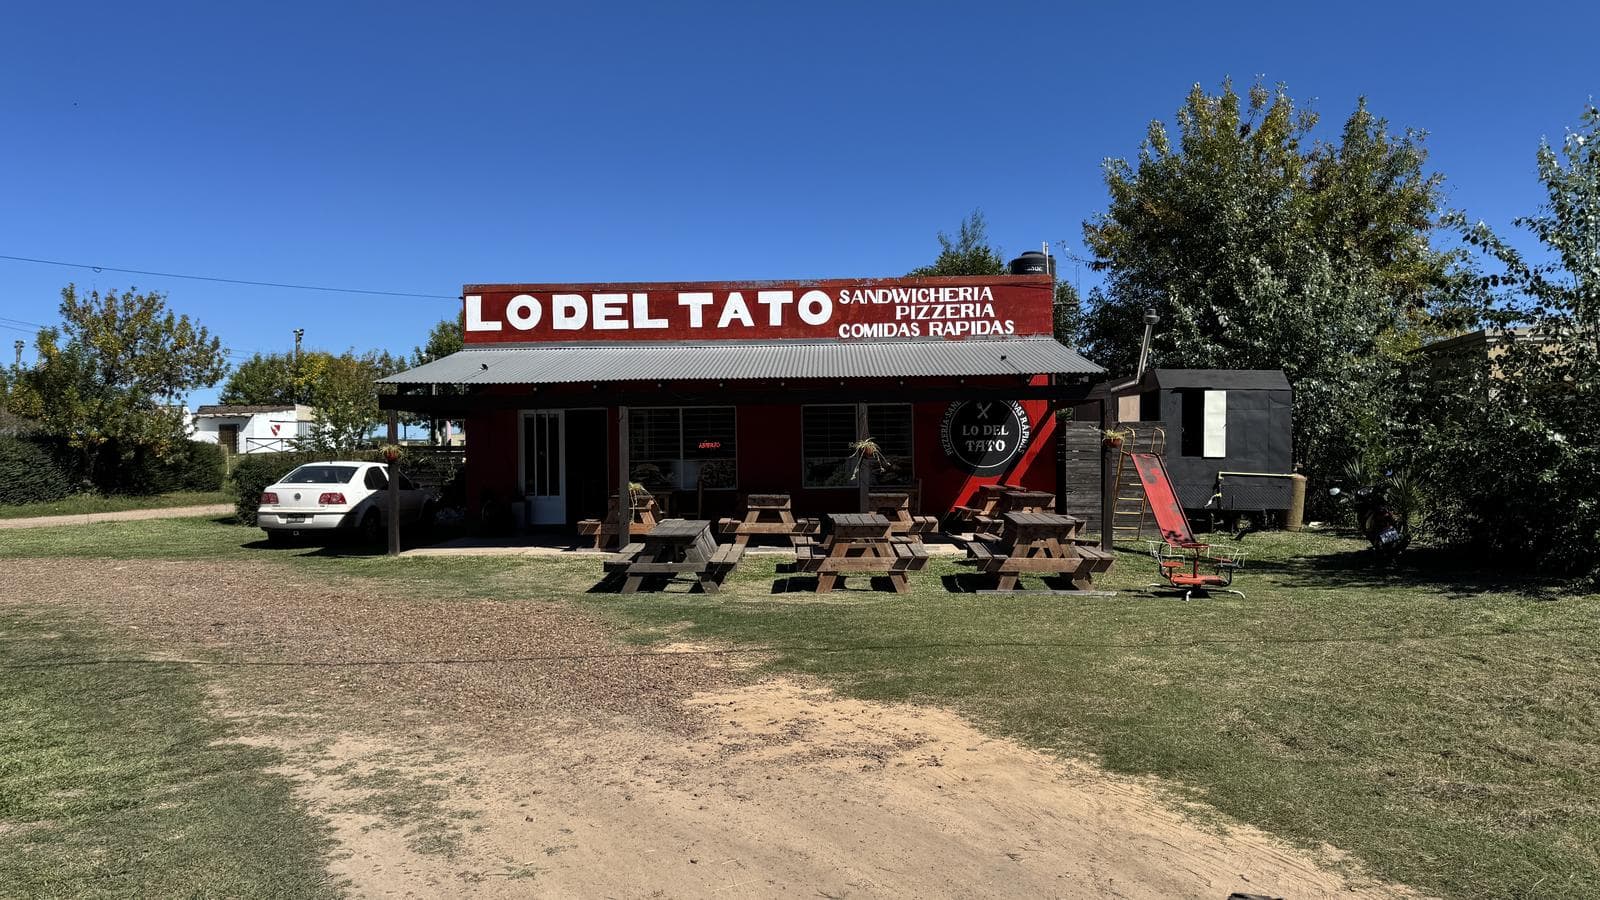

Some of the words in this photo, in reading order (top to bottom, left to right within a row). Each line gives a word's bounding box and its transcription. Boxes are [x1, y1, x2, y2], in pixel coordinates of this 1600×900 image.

[839, 286, 994, 304] SANDWICHERIA
[465, 294, 542, 331] LO
[552, 293, 669, 330] DEL
[678, 290, 833, 328] TATO
[896, 303, 995, 320] PIZZERIA
[838, 322, 921, 338] COMIDAS
[928, 319, 1015, 336] RAPIDAS
[962, 424, 979, 436] LO
[983, 424, 1009, 436] DEL
[965, 439, 1006, 452] TATO
